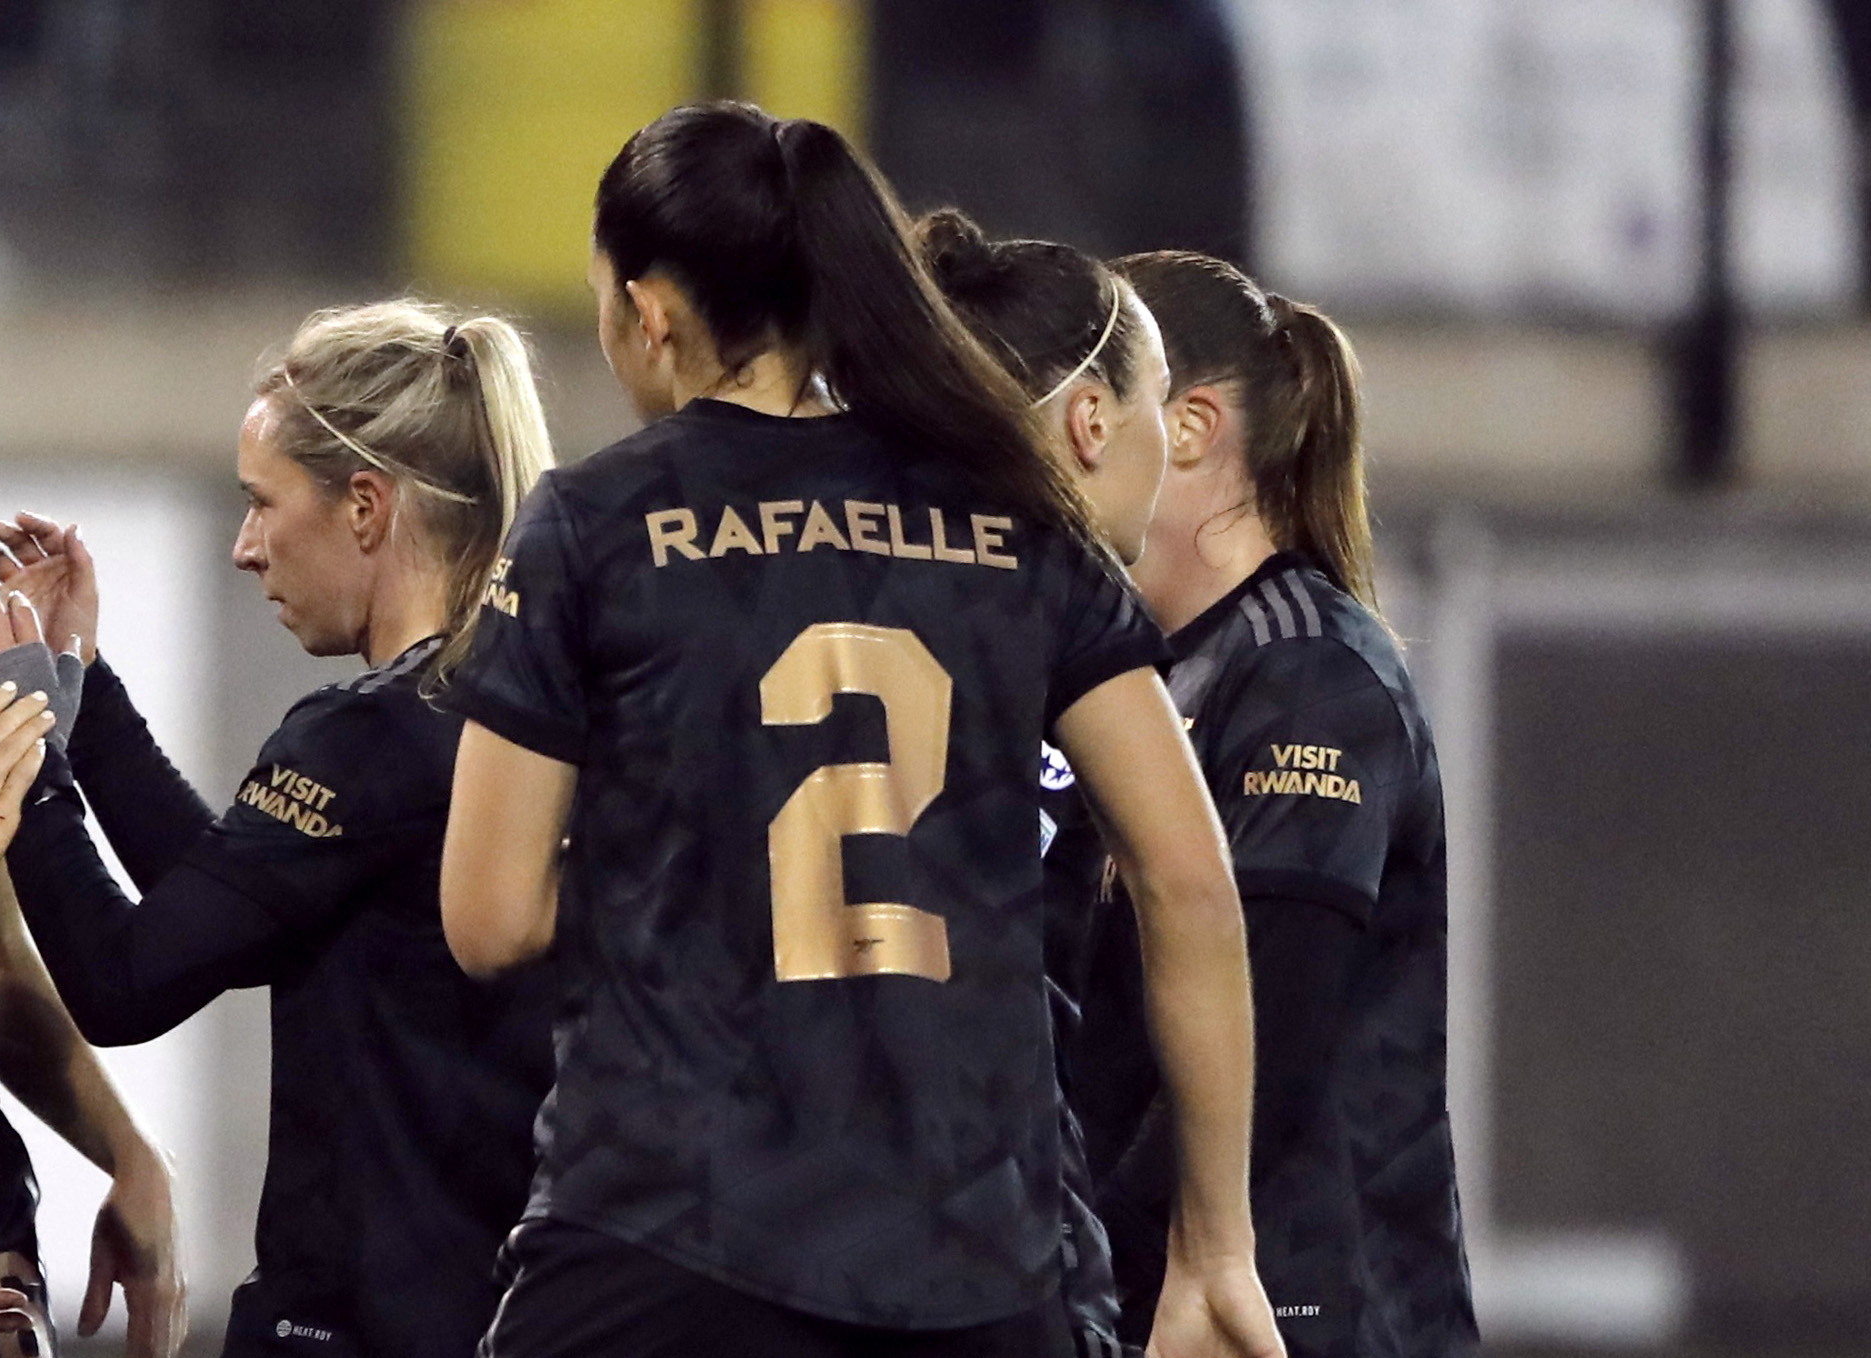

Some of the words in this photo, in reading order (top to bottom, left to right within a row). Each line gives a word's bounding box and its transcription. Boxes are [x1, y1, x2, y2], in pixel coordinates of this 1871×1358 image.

[644, 500, 1019, 570] RAFAELLE
[1271, 743, 1342, 772] VISIT
[271, 762, 337, 811] VISIT
[758, 621, 954, 984] 2
[1243, 771, 1362, 805] RWANDA
